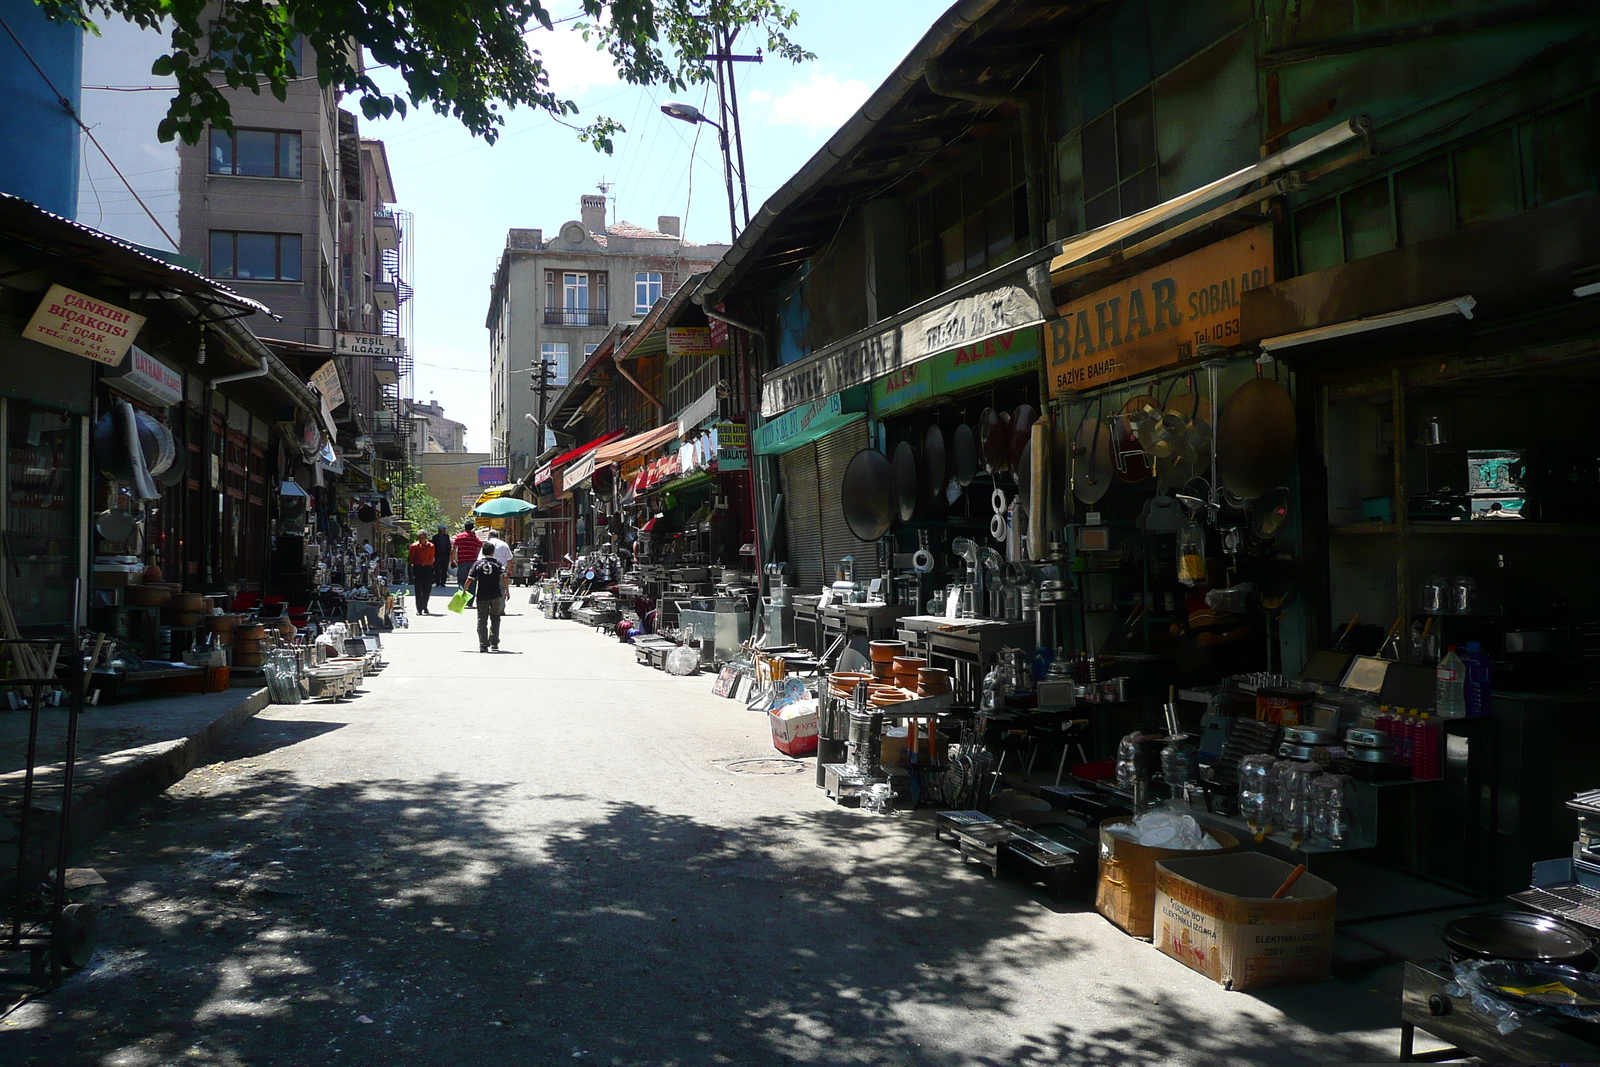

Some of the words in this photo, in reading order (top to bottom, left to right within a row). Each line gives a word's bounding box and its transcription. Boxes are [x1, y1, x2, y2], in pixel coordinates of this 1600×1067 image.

[63, 294, 130, 324] ÇANKIRI
[1051, 277, 1184, 367] BAHAR
[1188, 265, 1268, 322] SOBALARI
[47, 303, 129, 338] BIÇAKCISI
[38, 325, 64, 339] TEL:
[67, 336, 85, 346] 324
[72, 326, 106, 342] UÇAK
[355, 336, 384, 346] YEŞİL
[351, 345, 390, 355] ILGAZLI
[954, 331, 1015, 367] ALEV
[1087, 358, 1115, 378] BAHAR
[1191, 911, 1205, 923] BOY
